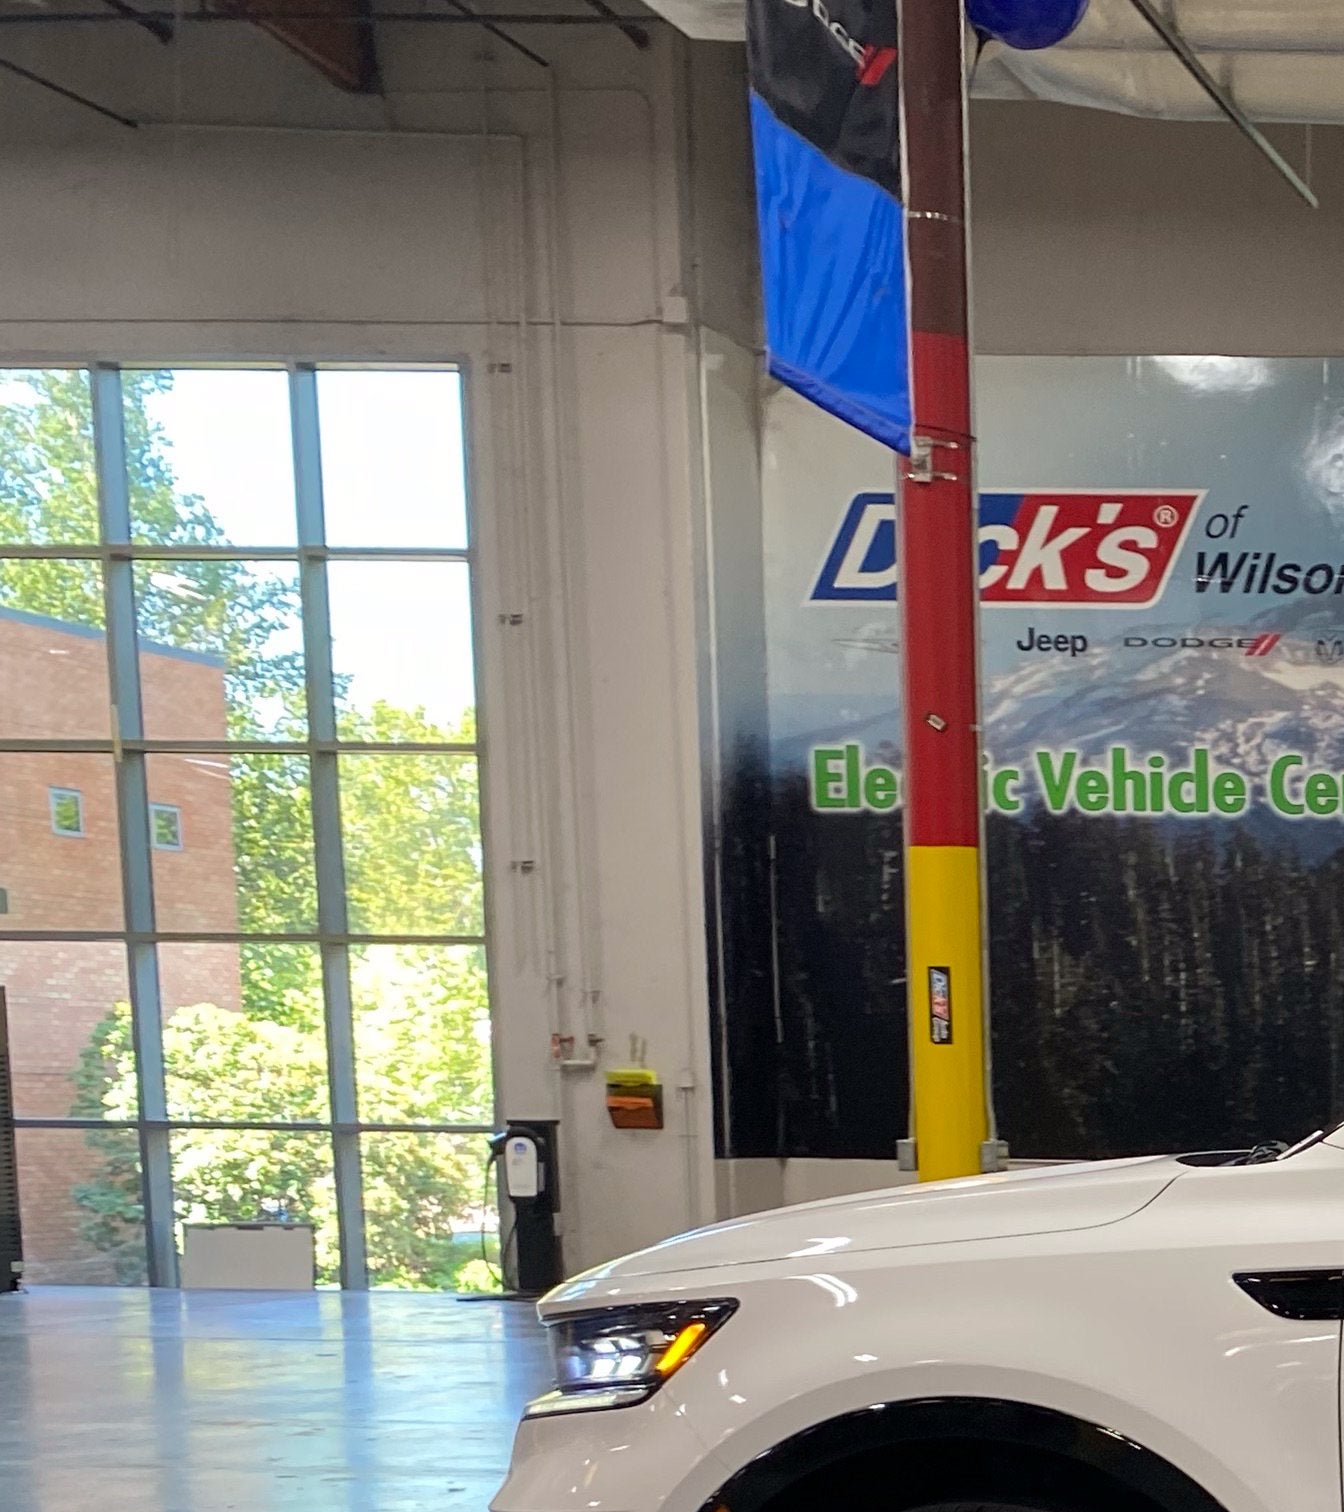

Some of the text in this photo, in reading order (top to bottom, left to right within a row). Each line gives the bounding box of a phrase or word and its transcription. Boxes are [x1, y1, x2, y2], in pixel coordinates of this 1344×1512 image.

[784, 0, 868, 69] DGE
[1205, 504, 1249, 539] of
[1016, 628, 1088, 656] Jeep
[1123, 636, 1258, 649] DODGE
[1036, 747, 1247, 814] Vehicle
